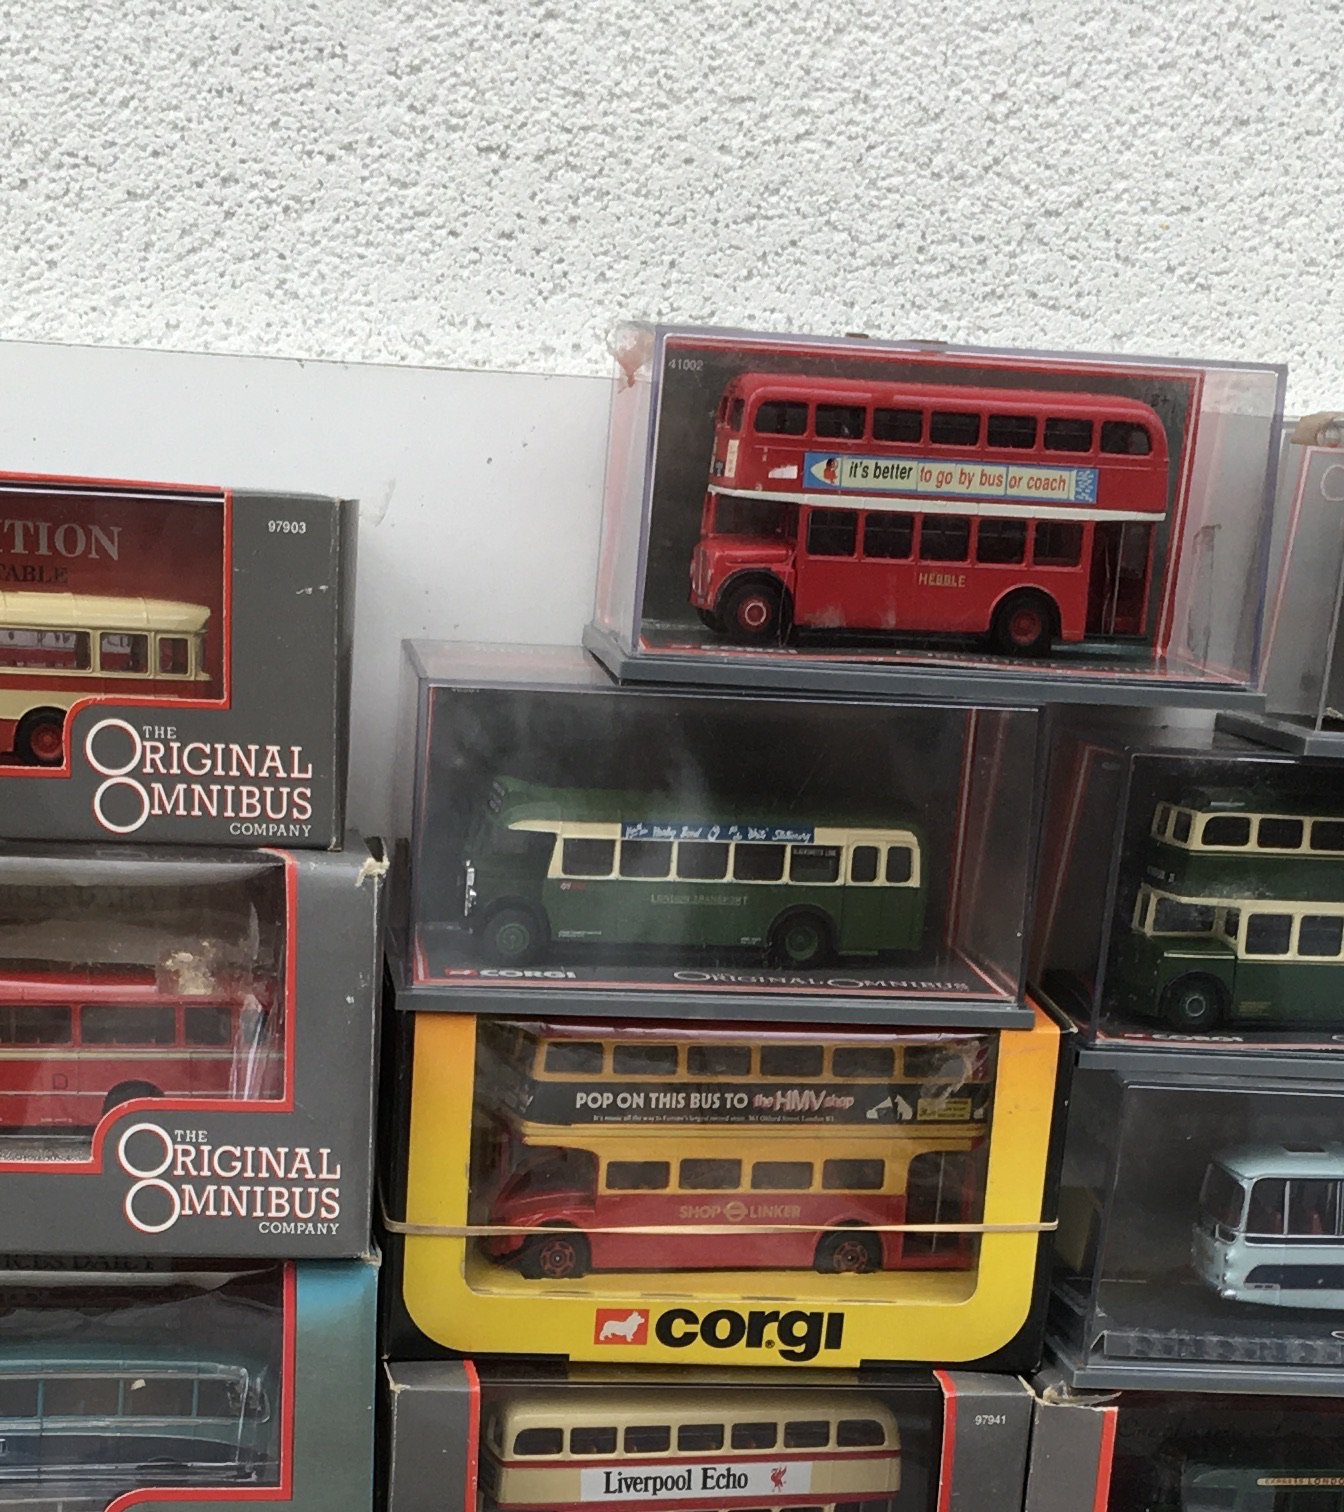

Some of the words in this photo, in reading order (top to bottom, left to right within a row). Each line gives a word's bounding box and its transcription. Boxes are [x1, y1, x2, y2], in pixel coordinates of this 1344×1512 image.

[849, 461, 869, 480] it's
[874, 463, 913, 483] better
[920, 467, 932, 482] to
[937, 470, 953, 488] go
[958, 468, 974, 489] by
[979, 470, 1004, 488] bus
[1008, 474, 1023, 490] or
[1028, 473, 1067, 492] coach
[268, 520, 306, 535] 97903
[918, 573, 966, 587] HEBBLE
[143, 725, 176, 738] THE
[86, 718, 312, 779] ORIGINAL
[92, 776, 312, 833] OMNIBUS
[229, 821, 312, 836] COMPANY
[576, 1092, 613, 1110] POP
[617, 1092, 645, 1110] ON
[649, 1092, 686, 1110] THIS
[689, 1092, 720, 1110] BUS
[724, 1092, 749, 1110] TO
[754, 1092, 774, 1109] the
[773, 1088, 826, 1113] HMV
[824, 1094, 855, 1110] shop
[174, 1130, 208, 1142] THE
[118, 1124, 341, 1180] ORIGINAL
[124, 1178, 341, 1235] OMNIBUS
[680, 1204, 724, 1220] SHOP
[750, 1204, 801, 1219] LINKER
[258, 1222, 340, 1236] COMPANY
[656, 1309, 844, 1362] corgi
[975, 1414, 1007, 1425] 97941
[604, 1468, 692, 1497] Liverpool
[700, 1466, 748, 1490] Echo
